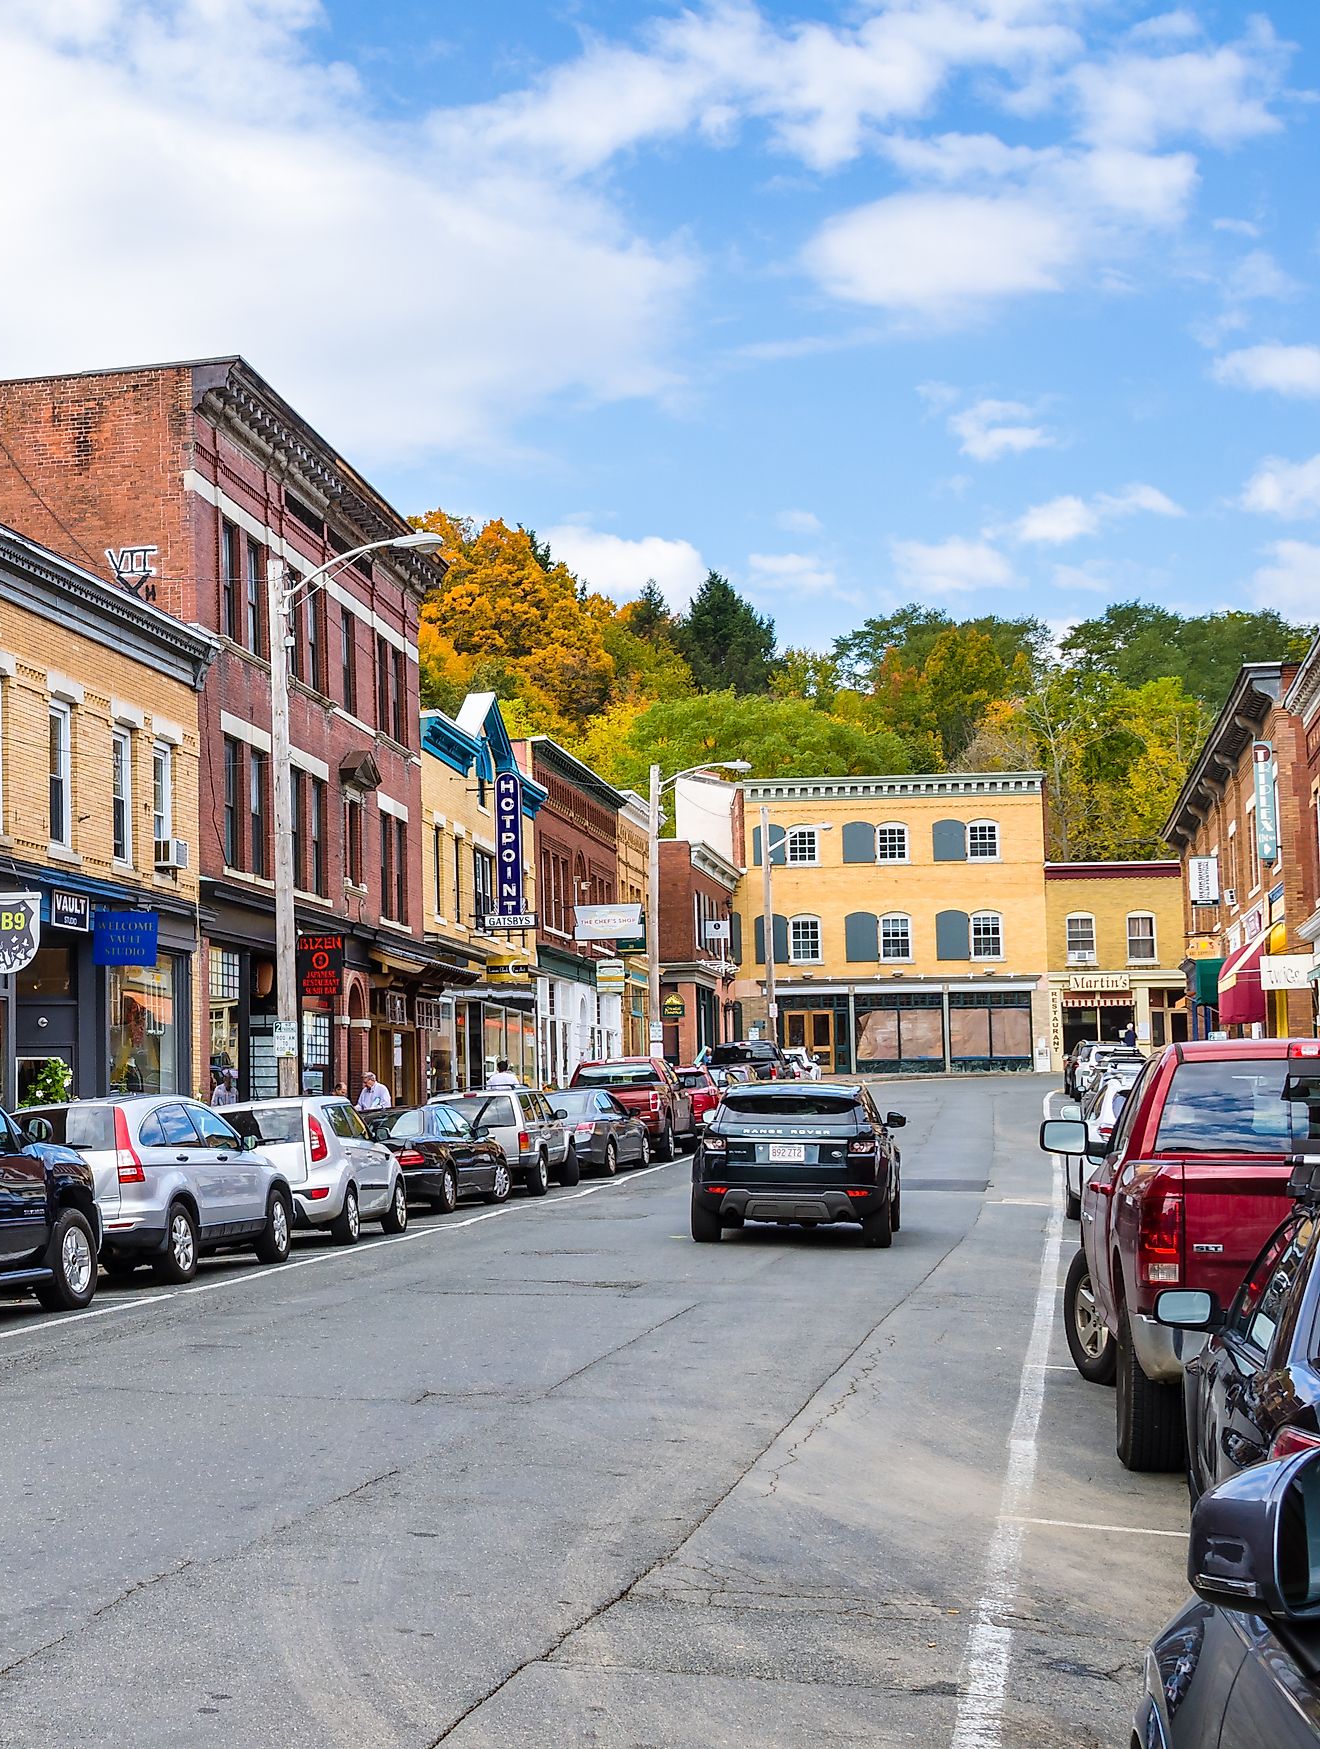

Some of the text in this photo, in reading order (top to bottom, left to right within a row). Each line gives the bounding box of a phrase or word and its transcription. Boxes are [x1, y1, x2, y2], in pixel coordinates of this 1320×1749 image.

[1254, 749, 1274, 831] TRIPLEX
[500, 779, 517, 914] HOTPOINT
[55, 893, 86, 915] VAULT
[63, 916, 78, 926] STUDIO
[98, 921, 155, 932] WELCOME
[488, 916, 531, 926] GATSBYS
[109, 935, 142, 944] VAULT
[299, 936, 343, 950] BIZEN
[104, 948, 146, 957] STUDIO
[1072, 976, 1128, 989] Martin's
[1051, 991, 1060, 1053] RESTAURANT
[771, 1148, 802, 1158] 892 ZT2
[1194, 1244, 1223, 1252] SLT
